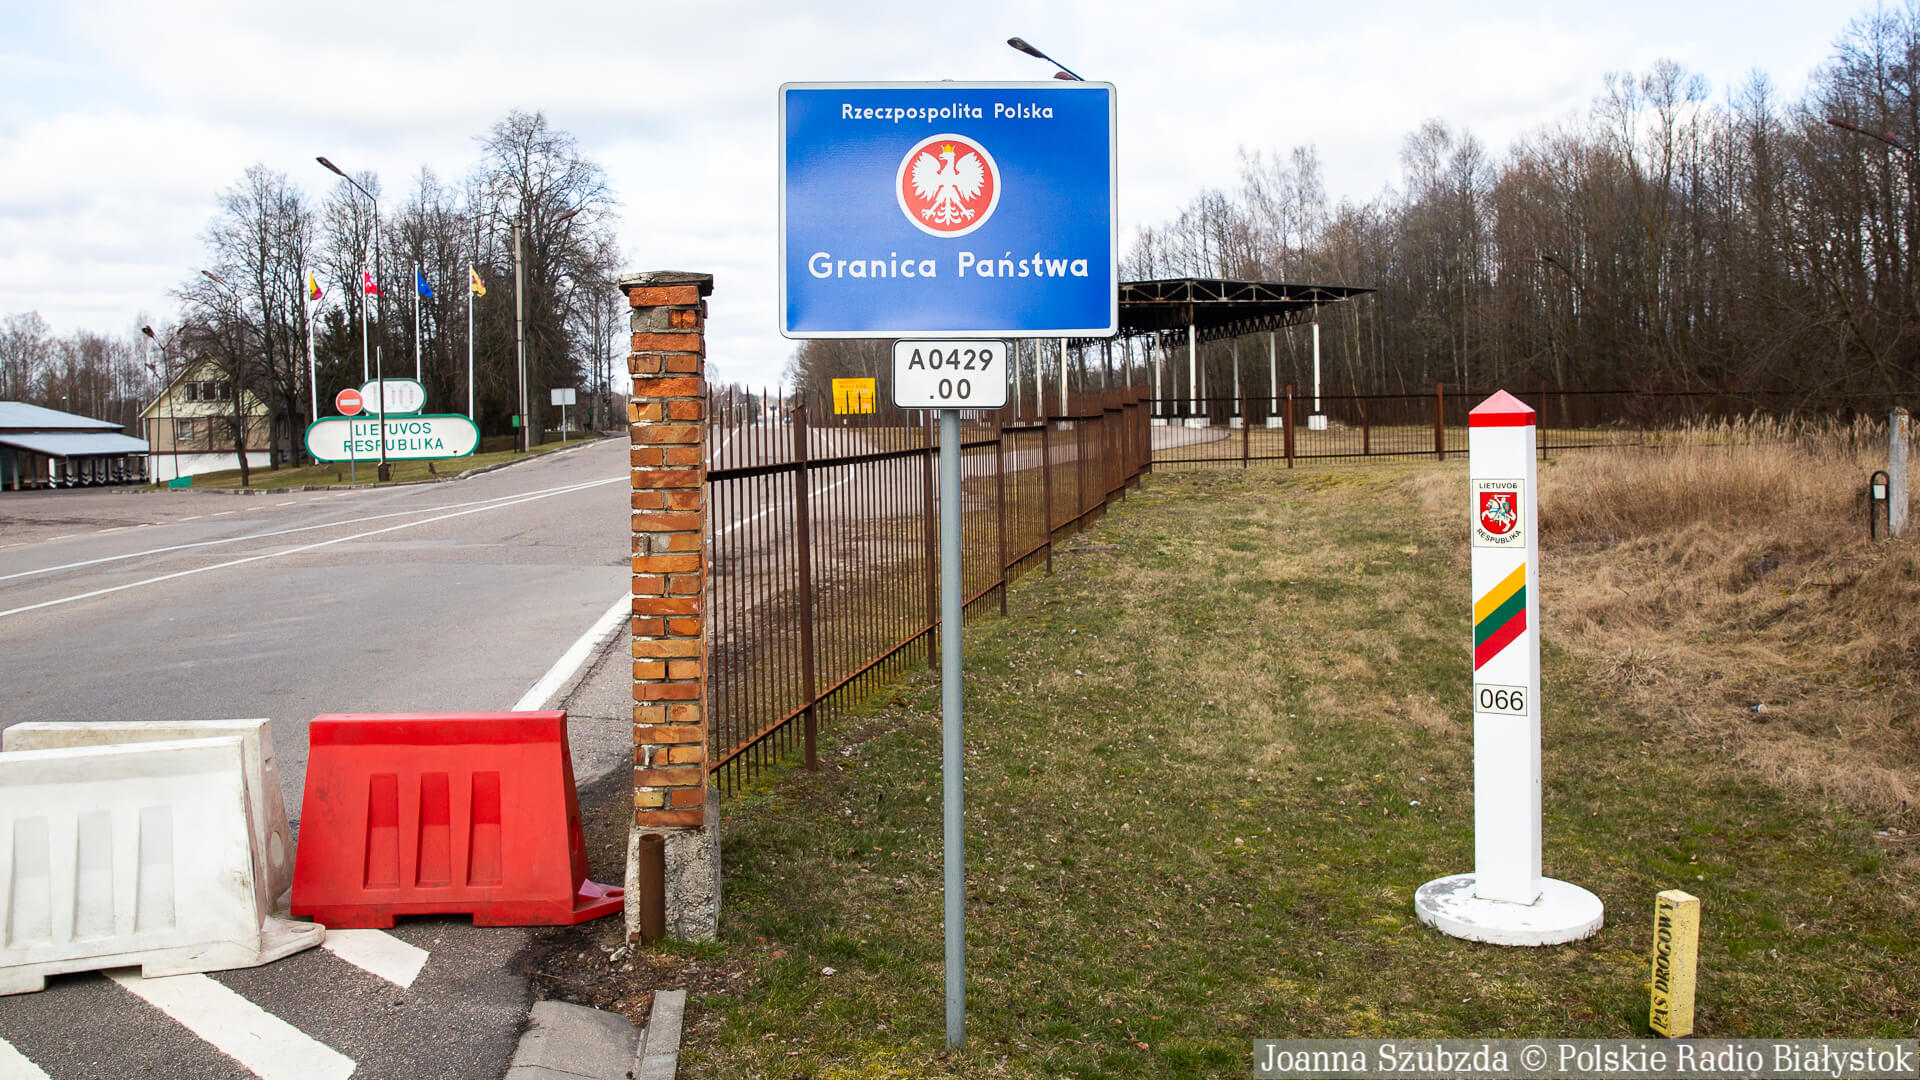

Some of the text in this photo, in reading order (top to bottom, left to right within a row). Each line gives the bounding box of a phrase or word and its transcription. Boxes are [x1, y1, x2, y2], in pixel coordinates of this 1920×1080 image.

[842, 102, 1053, 123] Rzeczpospolita Polska
[808, 250, 1089, 279] Granica Państwa
[908, 348, 993, 371] A0429
[929, 378, 971, 400] .00
[1476, 528, 1522, 544] RESPUBLIKA
[1480, 688, 1524, 711] 066
[1655, 903, 1674, 994] DROGOWY
